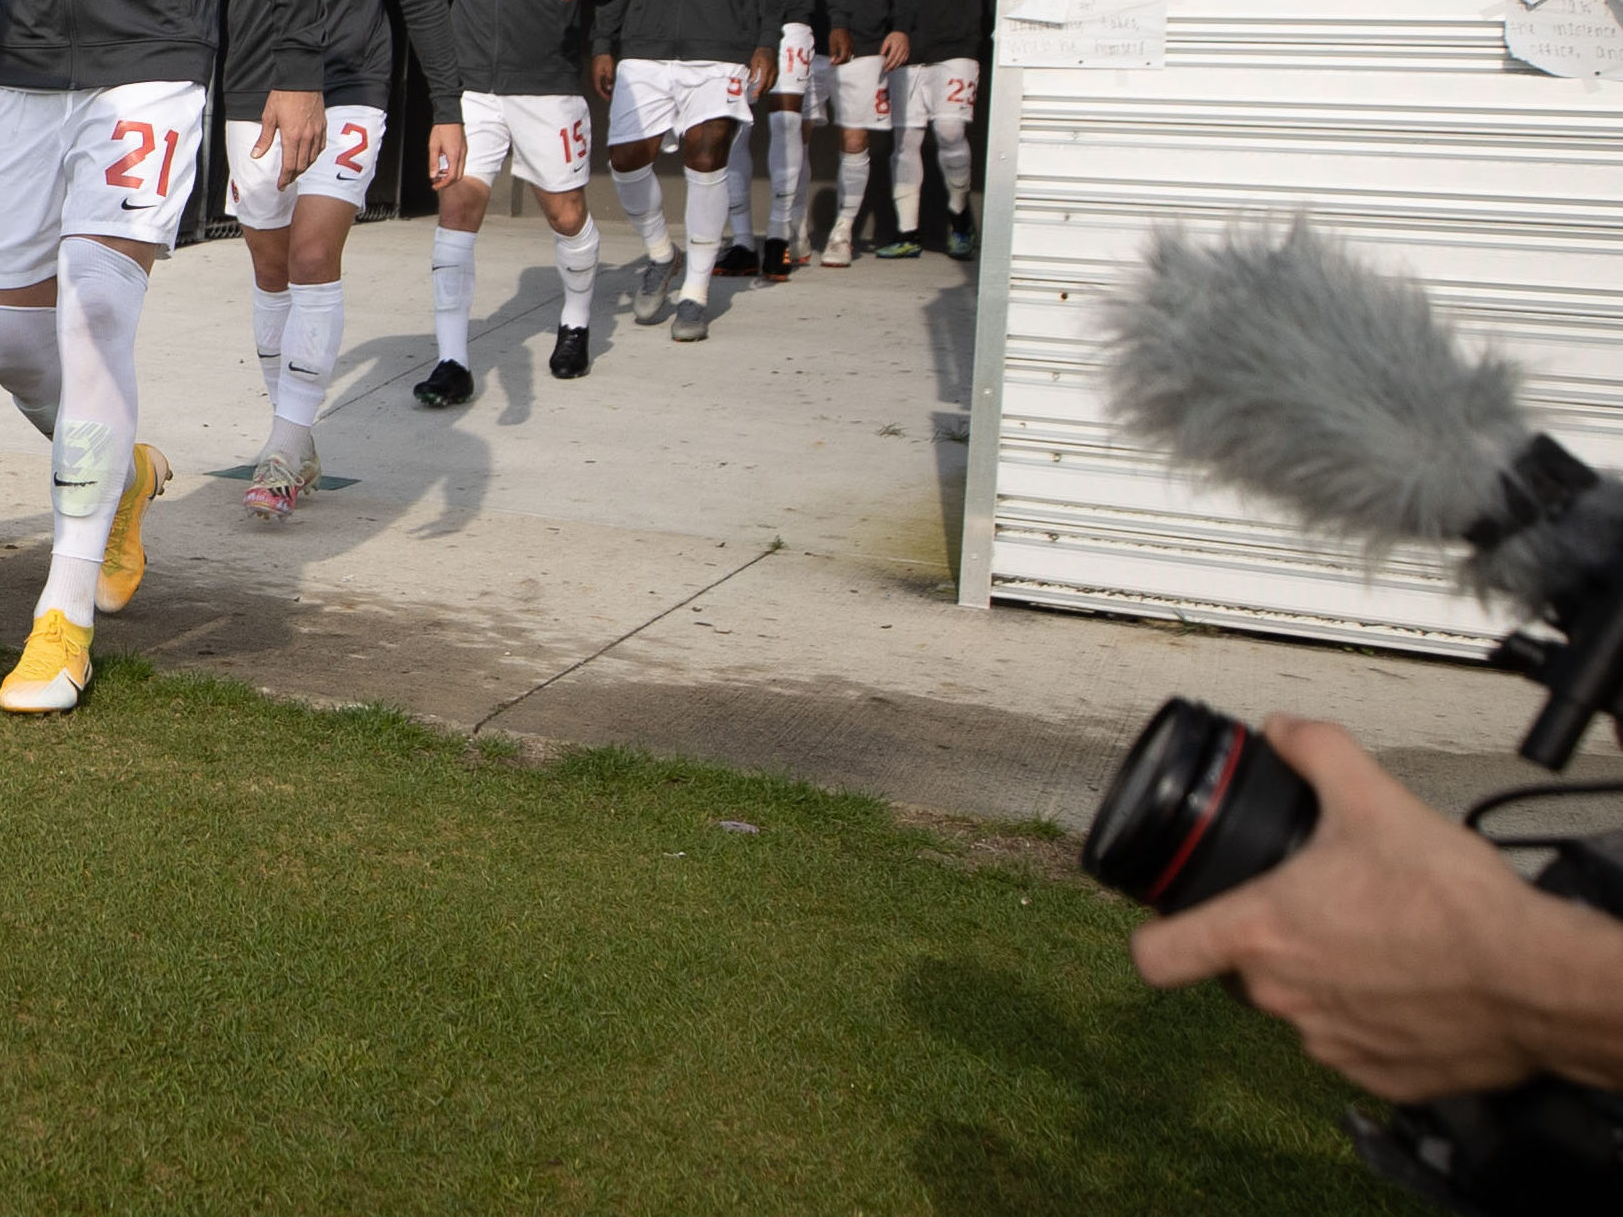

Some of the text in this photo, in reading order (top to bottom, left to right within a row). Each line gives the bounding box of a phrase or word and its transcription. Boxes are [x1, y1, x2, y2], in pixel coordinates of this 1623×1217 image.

[105, 120, 179, 197] 21
[335, 123, 369, 173] 2
[559, 119, 587, 164] 15
